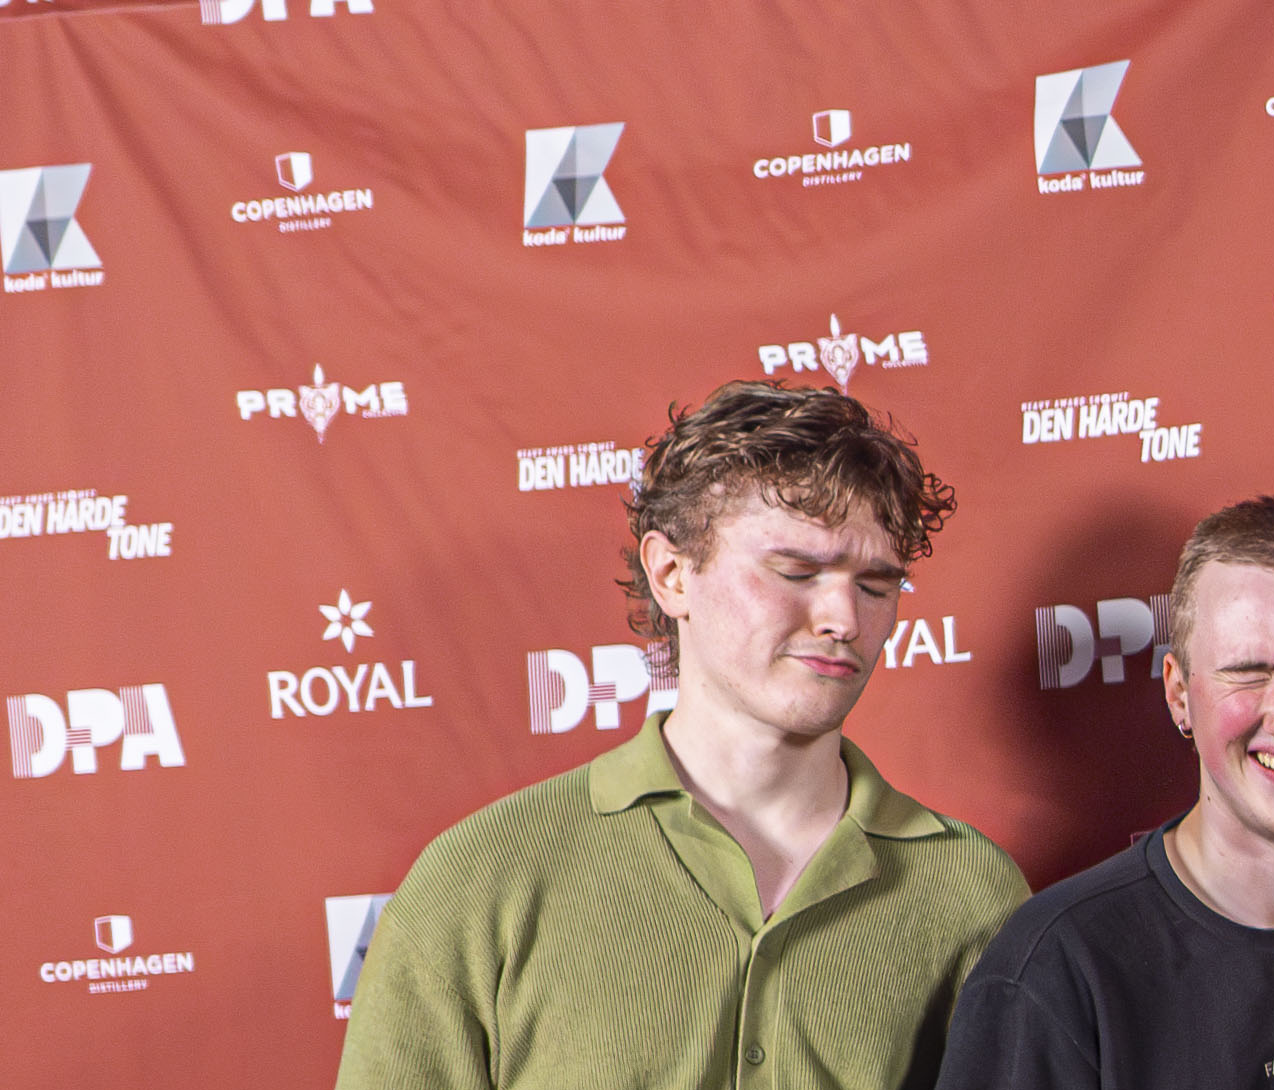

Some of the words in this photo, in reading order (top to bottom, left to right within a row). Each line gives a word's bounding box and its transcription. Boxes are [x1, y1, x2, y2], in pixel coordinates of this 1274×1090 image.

[753, 143, 911, 180] COPENHAGEN
[802, 171, 862, 188] DISTILLERY
[231, 189, 373, 224] COPENHAGEN
[1022, 407, 1074, 445] DEN
[1139, 423, 1202, 463] TONE
[518, 454, 565, 492] DEN
[0, 502, 43, 539] DEN
[106, 522, 174, 560] TONE
[268, 660, 432, 719] ROYAL
[7, 683, 186, 778] DPA
[40, 952, 194, 984] COPENHAGEN
